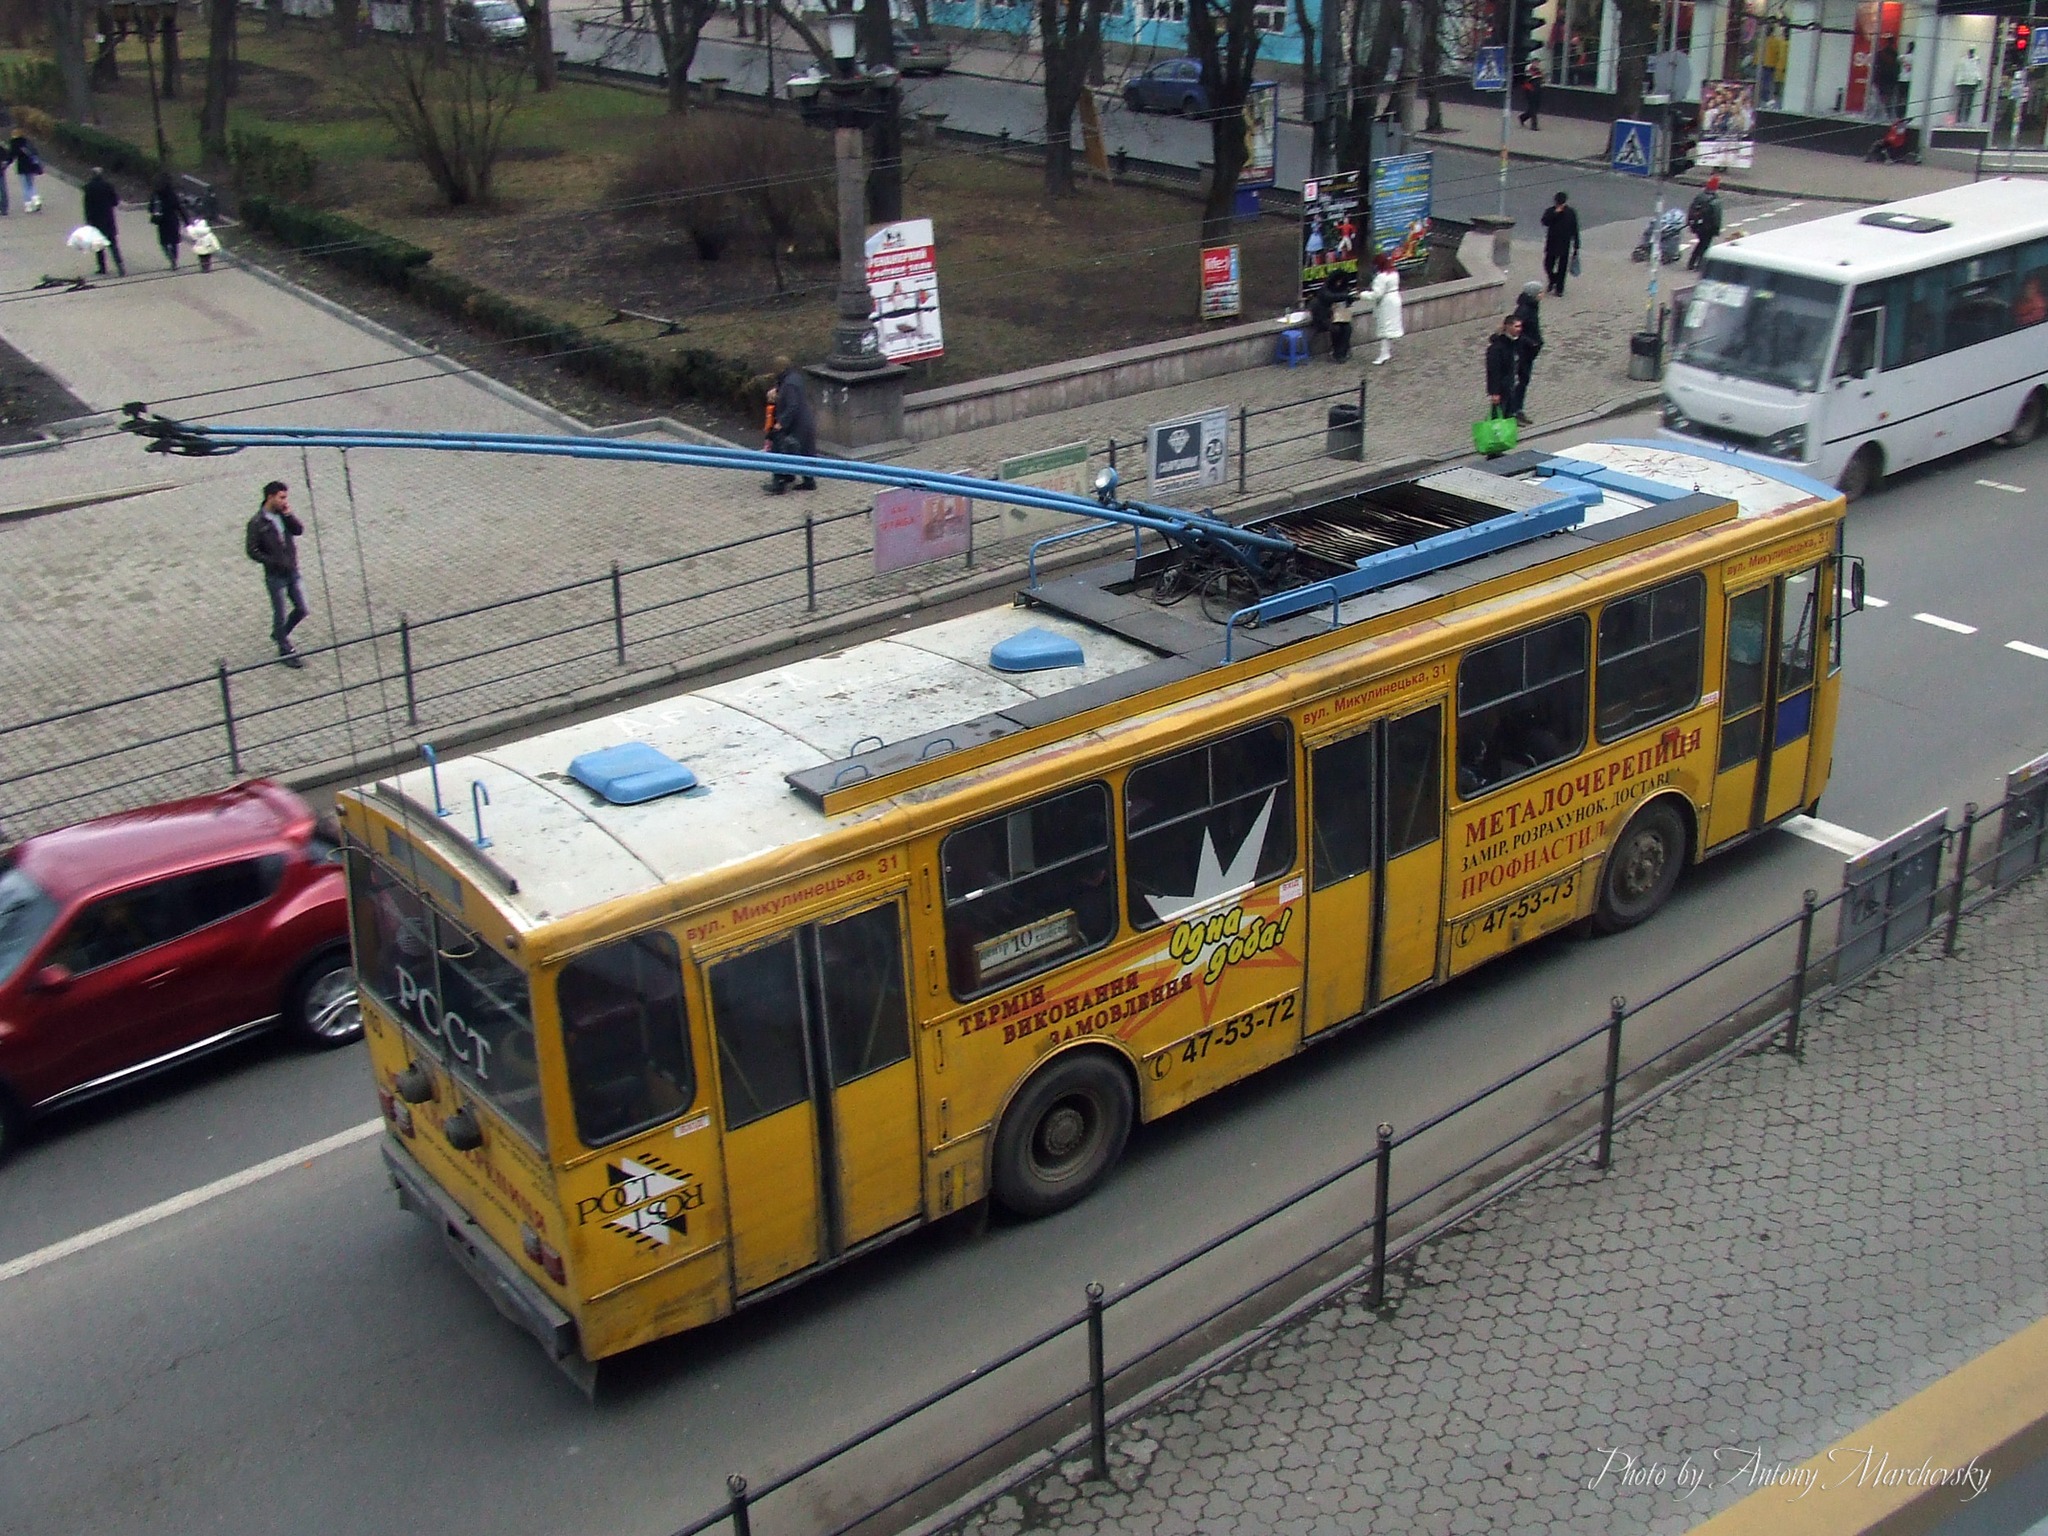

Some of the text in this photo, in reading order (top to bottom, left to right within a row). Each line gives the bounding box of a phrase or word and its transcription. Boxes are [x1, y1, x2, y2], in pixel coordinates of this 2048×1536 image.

[1818, 531, 1829, 544] 31
[1303, 663, 1446, 724] вул. Микулинецька, 31
[1465, 727, 1702, 847] МЕТАЛОЧЕРЕПИЦЯ
[1461, 820, 1607, 900] ПРОФНАСТИЛ
[686, 855, 898, 940] вул. Микулинецька, 31
[1482, 876, 1574, 935] 47-53-73
[1012, 930, 1033, 952] 10
[1169, 905, 1243, 965] Одна
[1203, 907, 1293, 985] доба!
[395, 964, 492, 1080] РОСТ
[958, 984, 1046, 1037] ТЕРМІН
[1003, 971, 1139, 1045] ВИКОНАННЯ
[1050, 972, 1193, 1047] ЗАМОВЛЕННЯ
[1182, 994, 1295, 1063] 47-53-72
[575, 1172, 656, 1226] РОСТ
